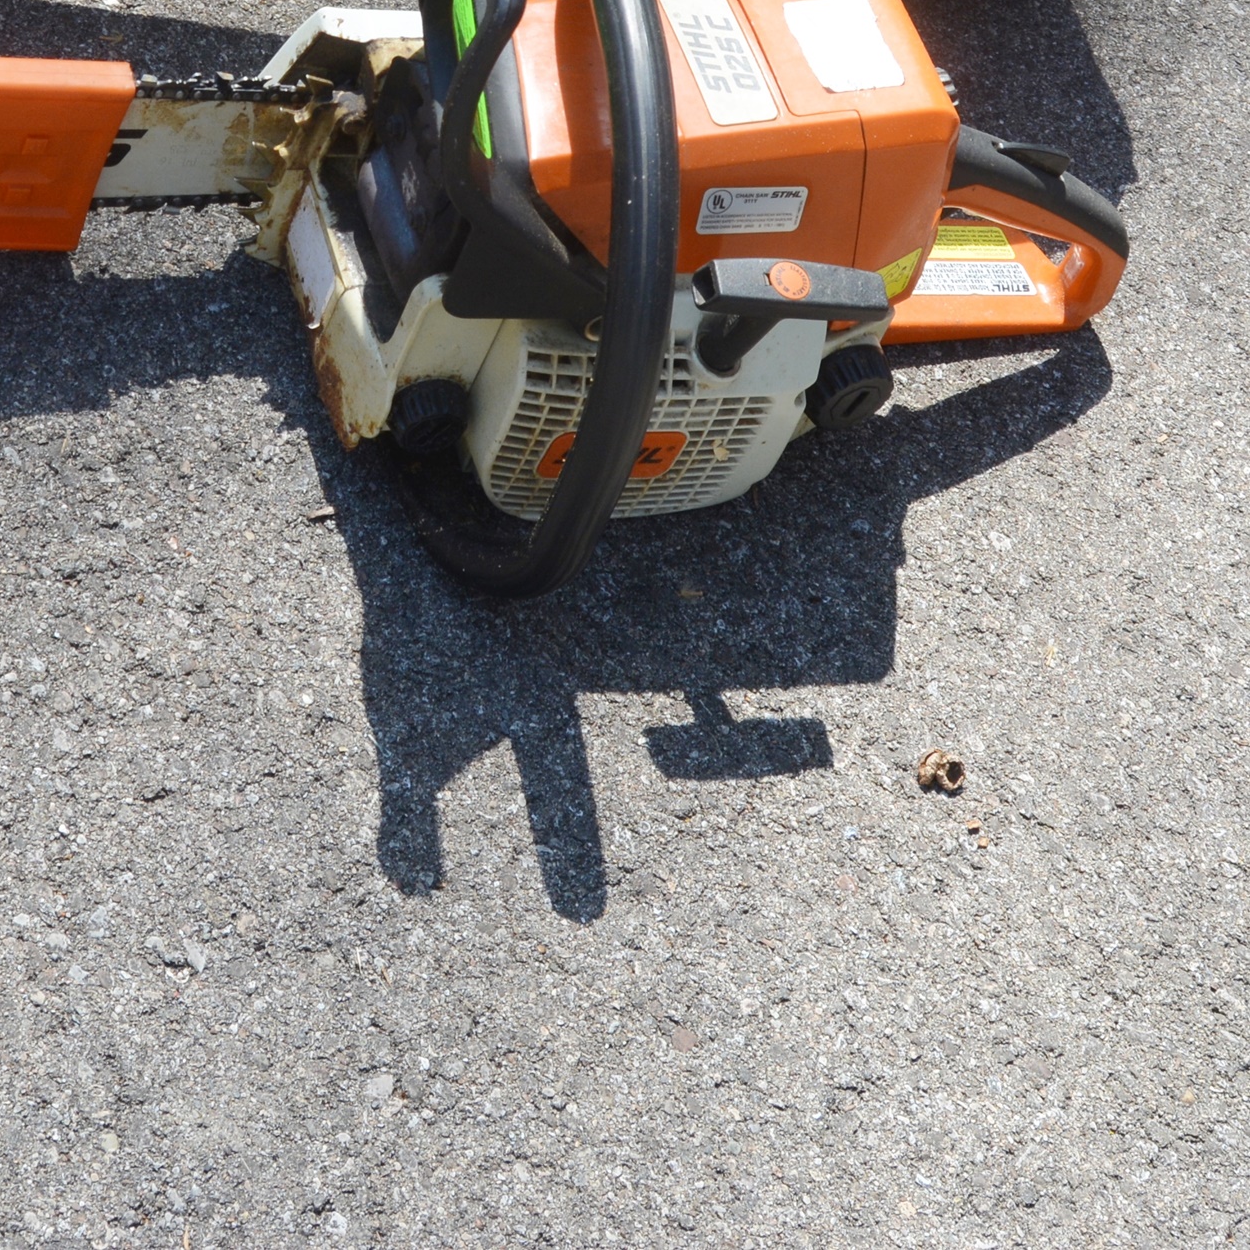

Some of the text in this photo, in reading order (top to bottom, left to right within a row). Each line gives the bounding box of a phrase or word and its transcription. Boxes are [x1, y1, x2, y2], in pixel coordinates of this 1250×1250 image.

[678, 14, 732, 93] STIHL
[706, 14, 761, 92] 025 C
[770, 190, 802, 198] STIHL
[993, 284, 1030, 292] STIHL
